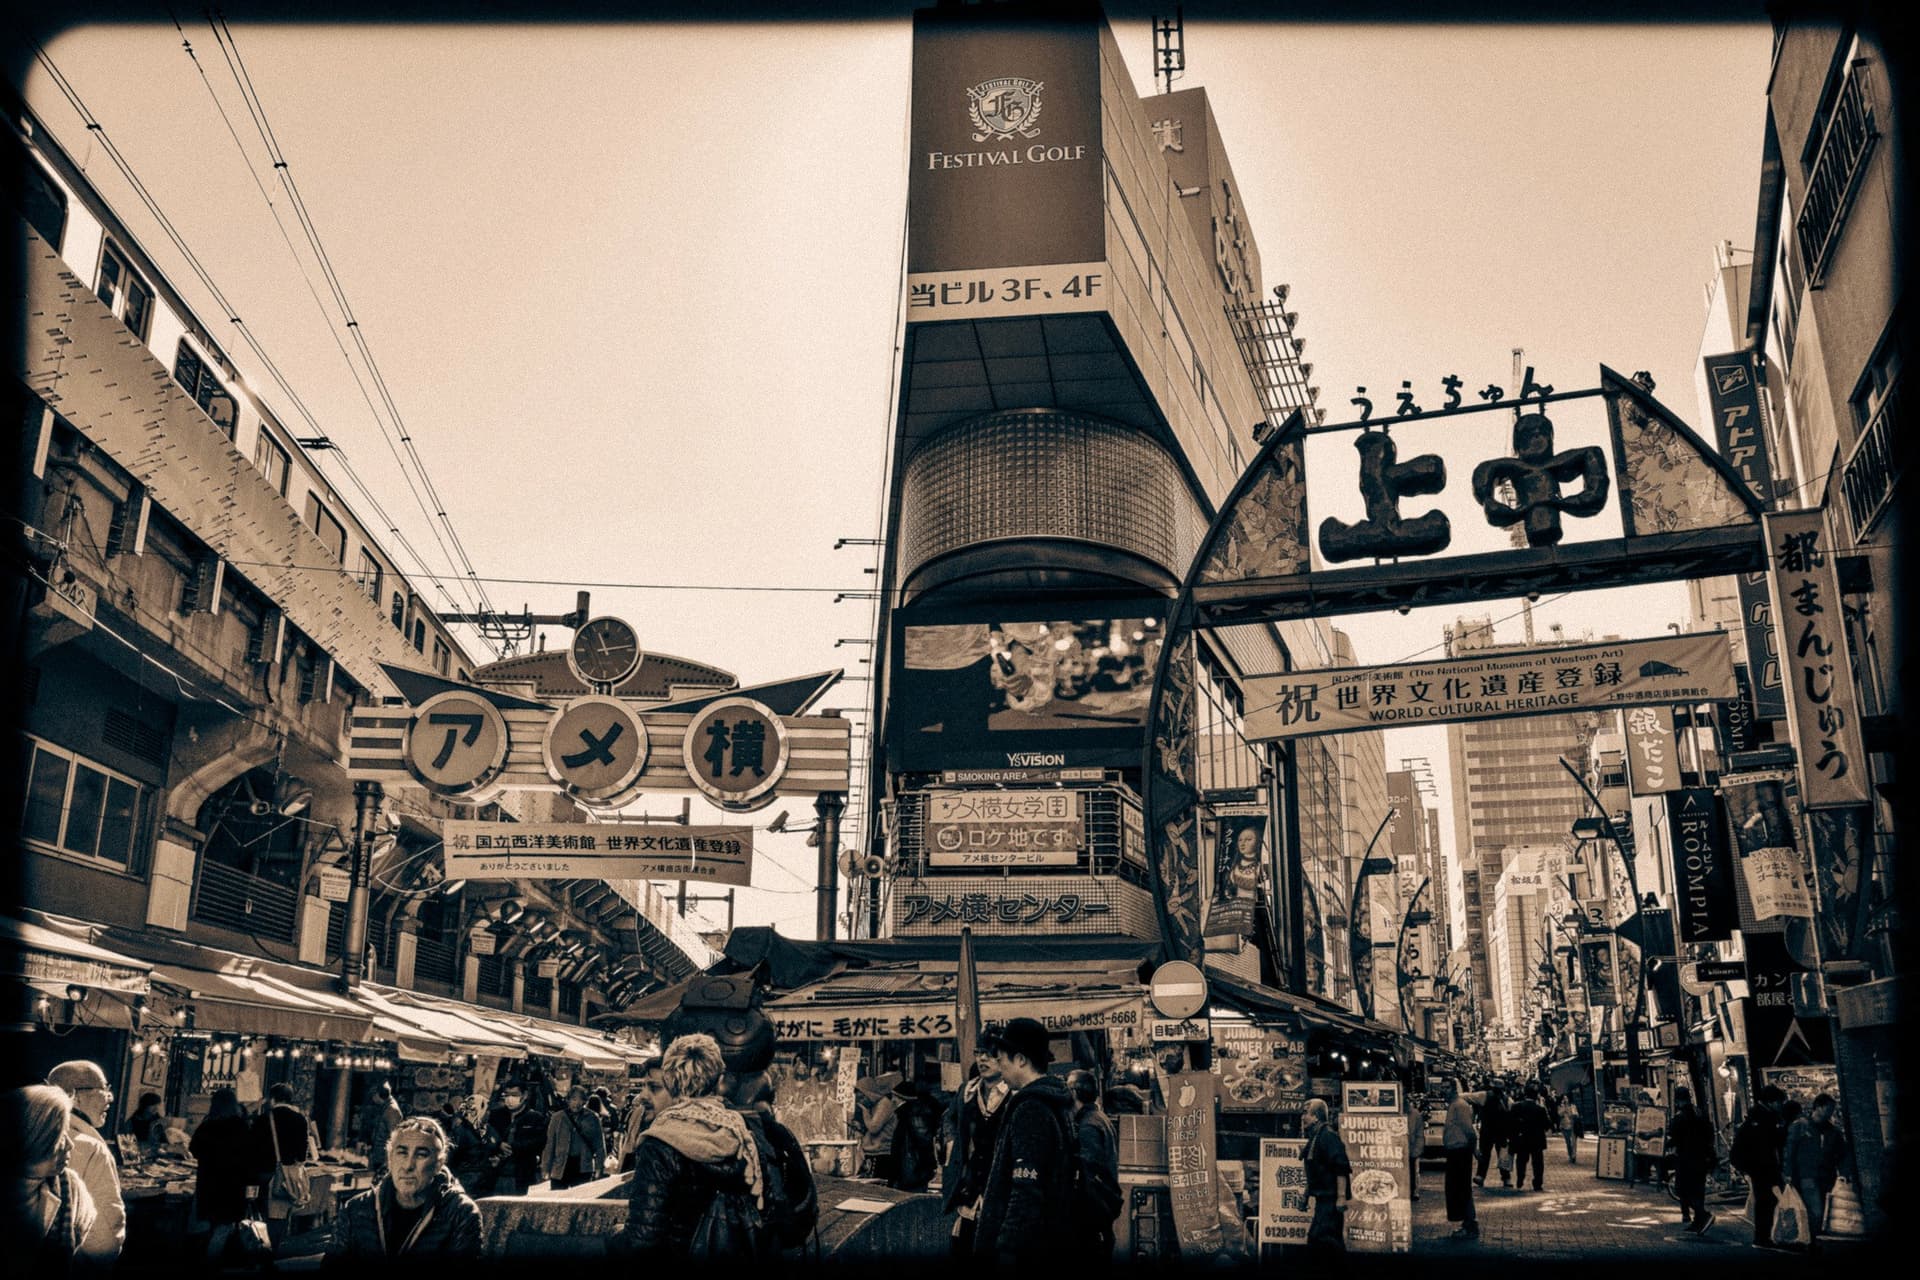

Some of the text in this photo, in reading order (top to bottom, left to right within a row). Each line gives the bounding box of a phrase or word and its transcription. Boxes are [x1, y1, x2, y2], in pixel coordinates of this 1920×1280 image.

[927, 143, 1087, 170] FESTIVAL GOLF
[1437, 663, 1484, 676] National
[1535, 657, 1548, 667] of
[1275, 661, 1624, 726] 祝 世界文化遺産登録
[1370, 692, 1579, 722] WORLD CULTURAL HERITAGE
[429, 713, 766, 777] アメ横
[1628, 708, 1671, 788] 銀だこ
[957, 772, 1001, 782] SMOKING
[1002, 770, 1028, 781] AREA
[475, 834, 597, 850] 国立西洋美術館
[962, 853, 1045, 864] アメ横センタービル
[1681, 821, 1712, 936] ROOMPIA
[903, 893, 1111, 925] アメ横センター
[833, 1017, 889, 1036] 毛がに
[899, 1013, 951, 1034] まぐろ
[1224, 1028, 1265, 1040] JUMBO
[1224, 1041, 1305, 1054] DONER KEBAB
[1348, 1131, 1393, 1145] DONER
[1360, 1145, 1405, 1159] KEBAB
